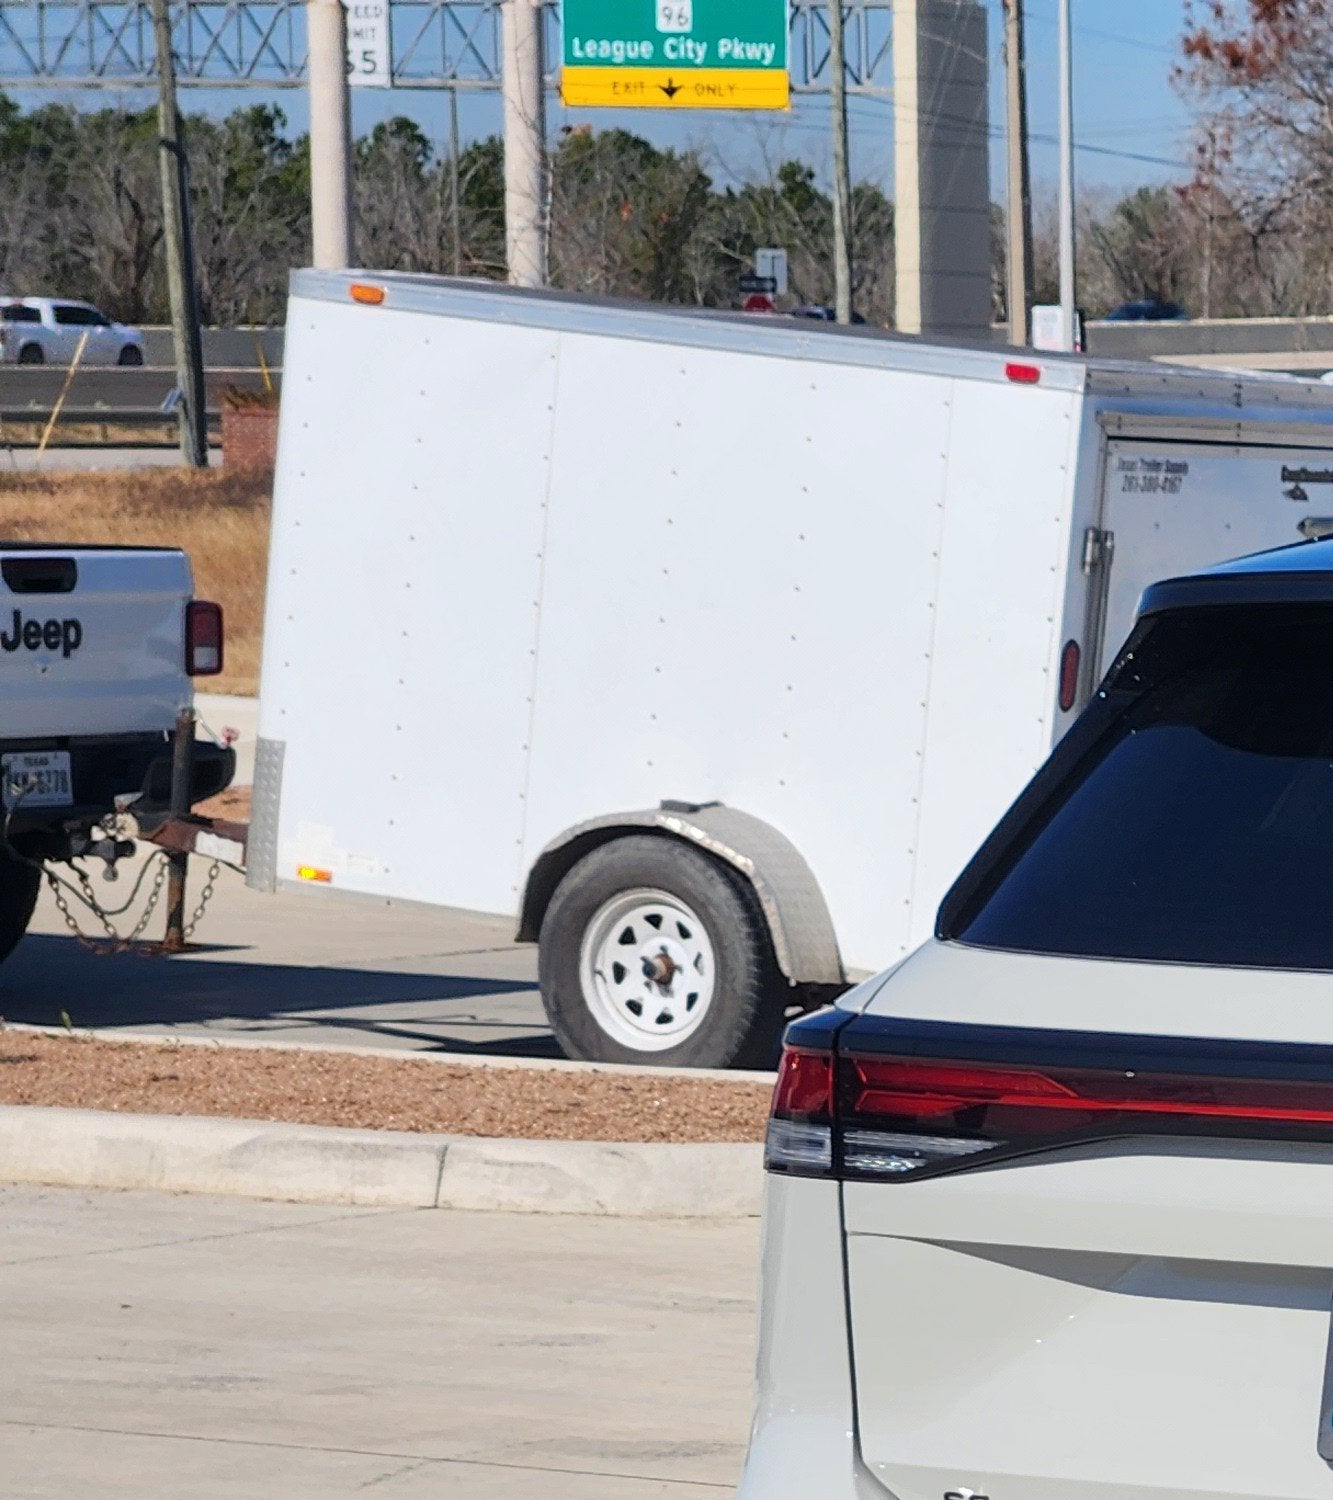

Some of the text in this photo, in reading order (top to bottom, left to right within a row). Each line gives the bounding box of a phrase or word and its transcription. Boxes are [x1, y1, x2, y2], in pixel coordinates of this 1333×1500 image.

[661, 6, 690, 27] 96
[571, 36, 776, 66] League City Pkwy
[610, 80, 738, 98] EXIT ONLY
[0, 607, 83, 659] Jeep
